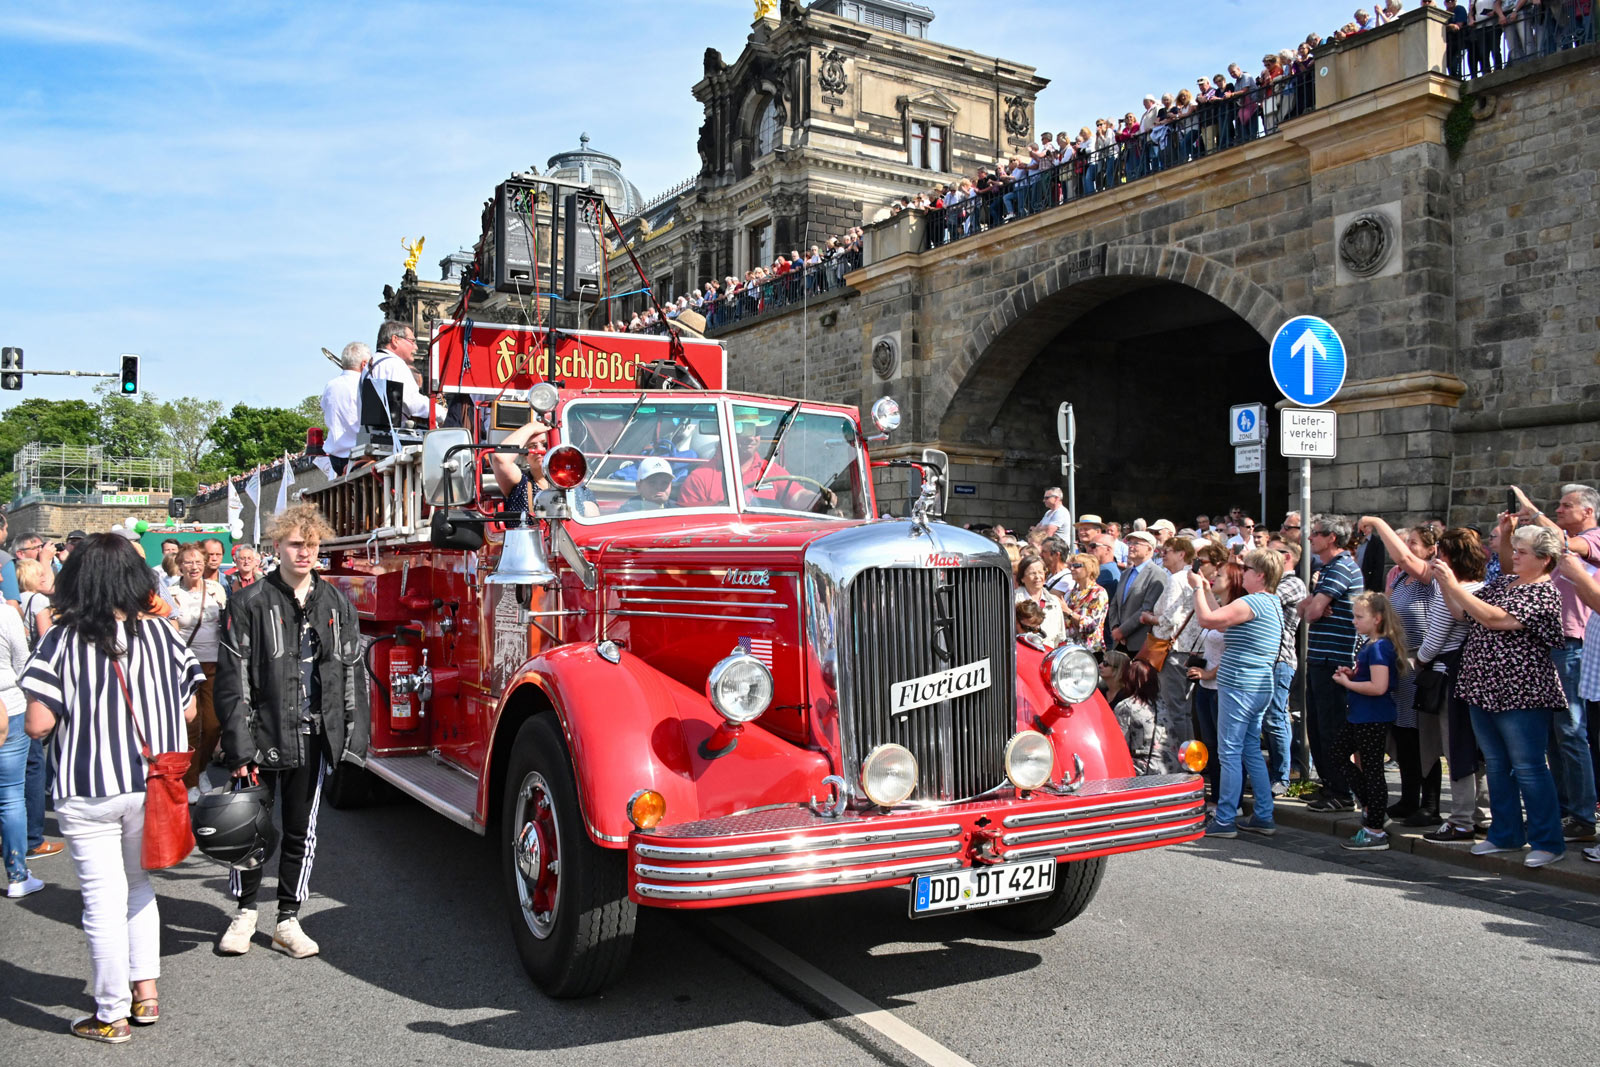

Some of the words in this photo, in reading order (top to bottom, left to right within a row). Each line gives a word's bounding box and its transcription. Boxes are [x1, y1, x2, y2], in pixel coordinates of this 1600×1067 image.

[496, 335, 646, 384] Feldschlößch
[1292, 415, 1325, 425] Liefer-
[1238, 432, 1253, 440] ZONE
[1290, 429, 1328, 439] verkehr
[1300, 441, 1317, 451] frei
[925, 553, 961, 567] Mack
[721, 567, 770, 586] Mack
[898, 666, 988, 708] Florian
[920, 897, 926, 905] D
[930, 876, 960, 904] DD
[976, 869, 1005, 897] DT
[1009, 863, 1052, 892] 42H
